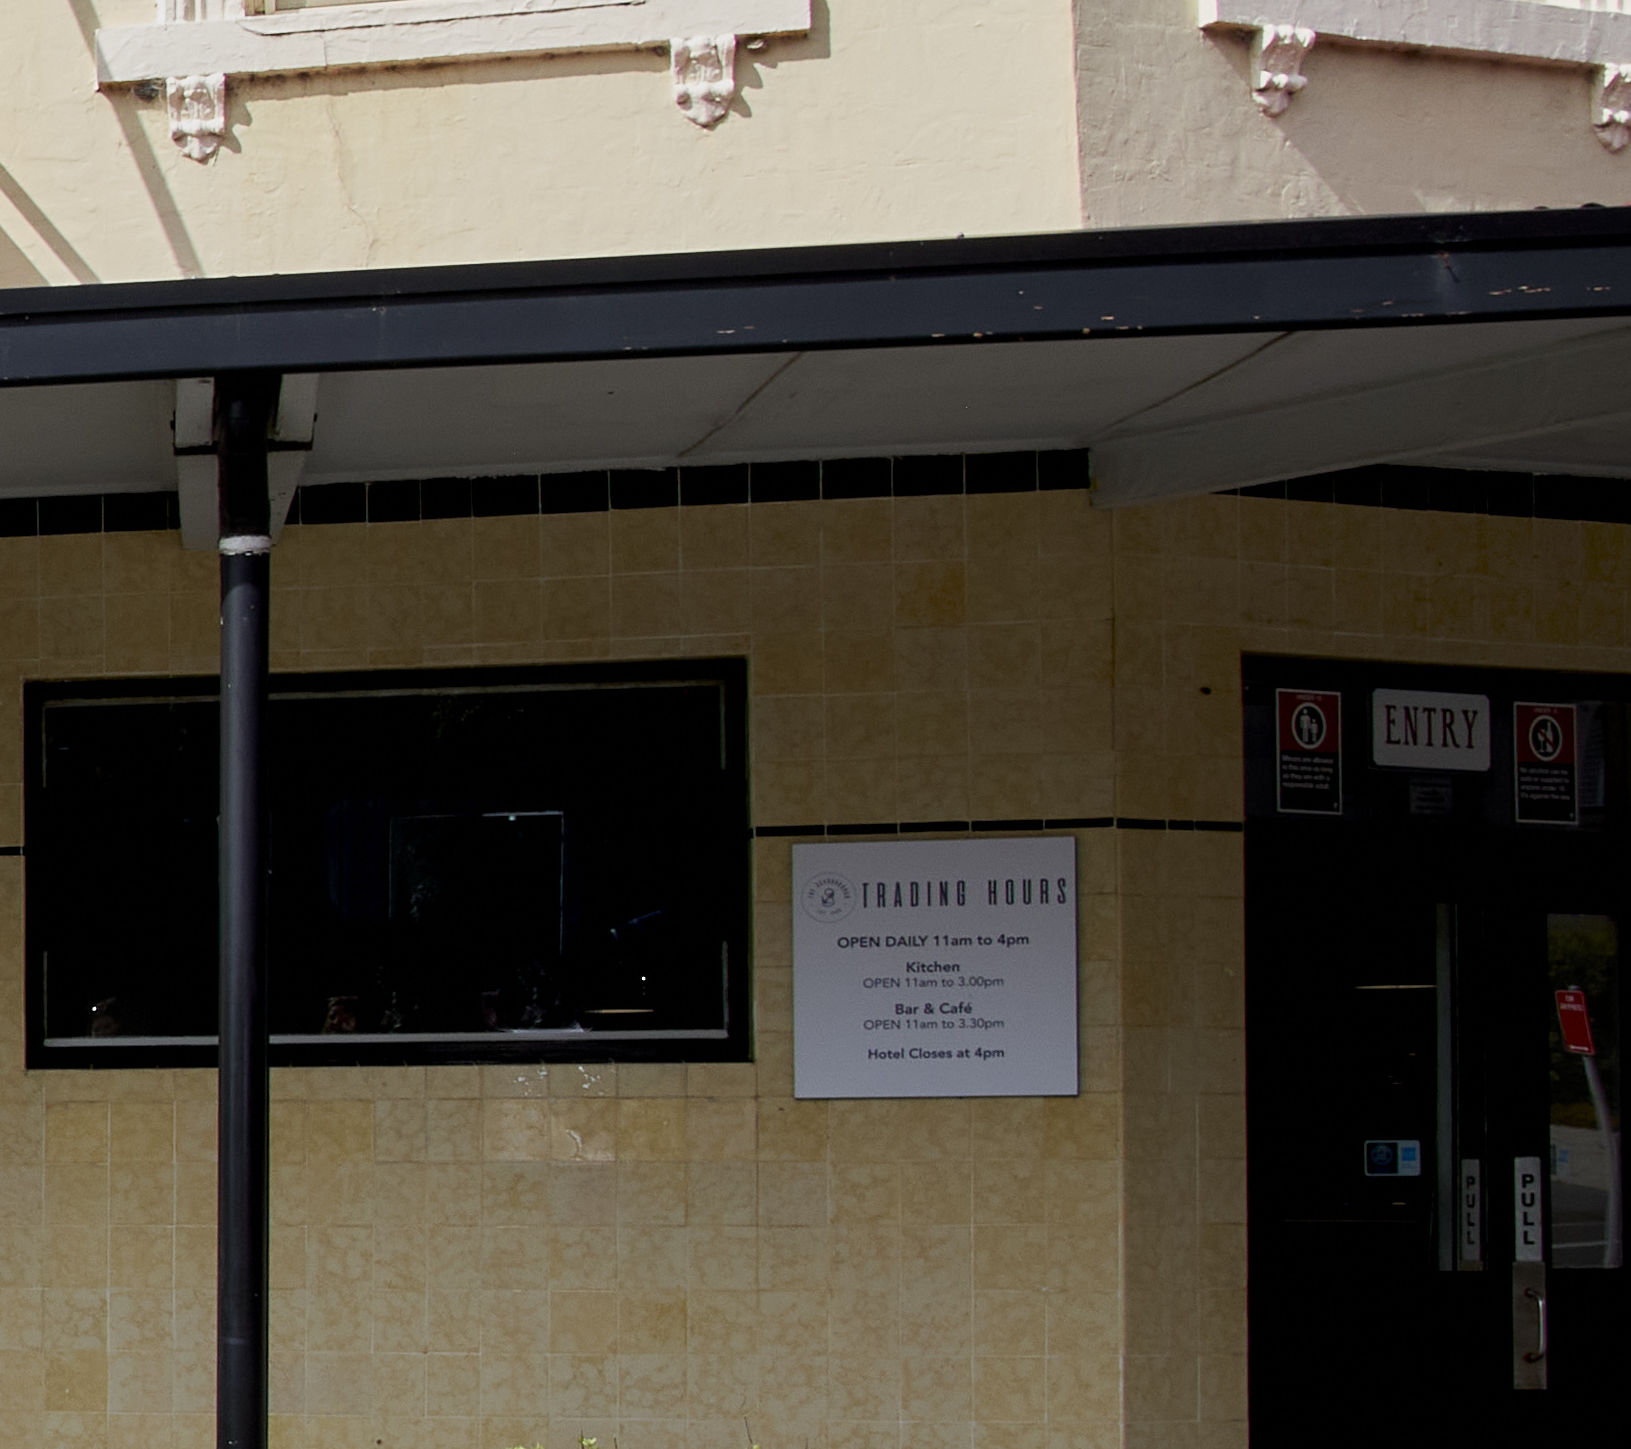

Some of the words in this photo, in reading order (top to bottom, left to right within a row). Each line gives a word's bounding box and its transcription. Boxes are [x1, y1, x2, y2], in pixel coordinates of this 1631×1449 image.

[1385, 705, 1478, 749] ENTRY
[862, 880, 966, 908] TRADING
[988, 878, 1066, 905] HOURS
[837, 936, 880, 948] OPEN
[885, 935, 927, 947] DAILY
[933, 935, 972, 946] 11am
[977, 935, 992, 946] to
[997, 934, 1029, 948] 4pm
[906, 961, 960, 973] Kitchen
[863, 977, 900, 989] OPEN
[905, 977, 937, 987] 11am
[942, 977, 954, 987] to
[958, 976, 1004, 989] 3.00pm
[895, 1004, 918, 1014] Bar
[924, 1003, 934, 1014] &
[939, 1002, 972, 1014] Café
[863, 1019, 900, 1030] OPEN
[906, 1020, 938, 1030] 11am
[942, 1019, 954, 1029] to
[958, 1018, 1004, 1031] 3.30pm
[868, 1049, 904, 1059] Hotel
[909, 1048, 952, 1059] Closes
[957, 1049, 969, 1058] at
[974, 1048, 1004, 1060] 4pm
[1467, 1176, 1475, 1244] PULL
[1522, 1174, 1534, 1244] PULL
